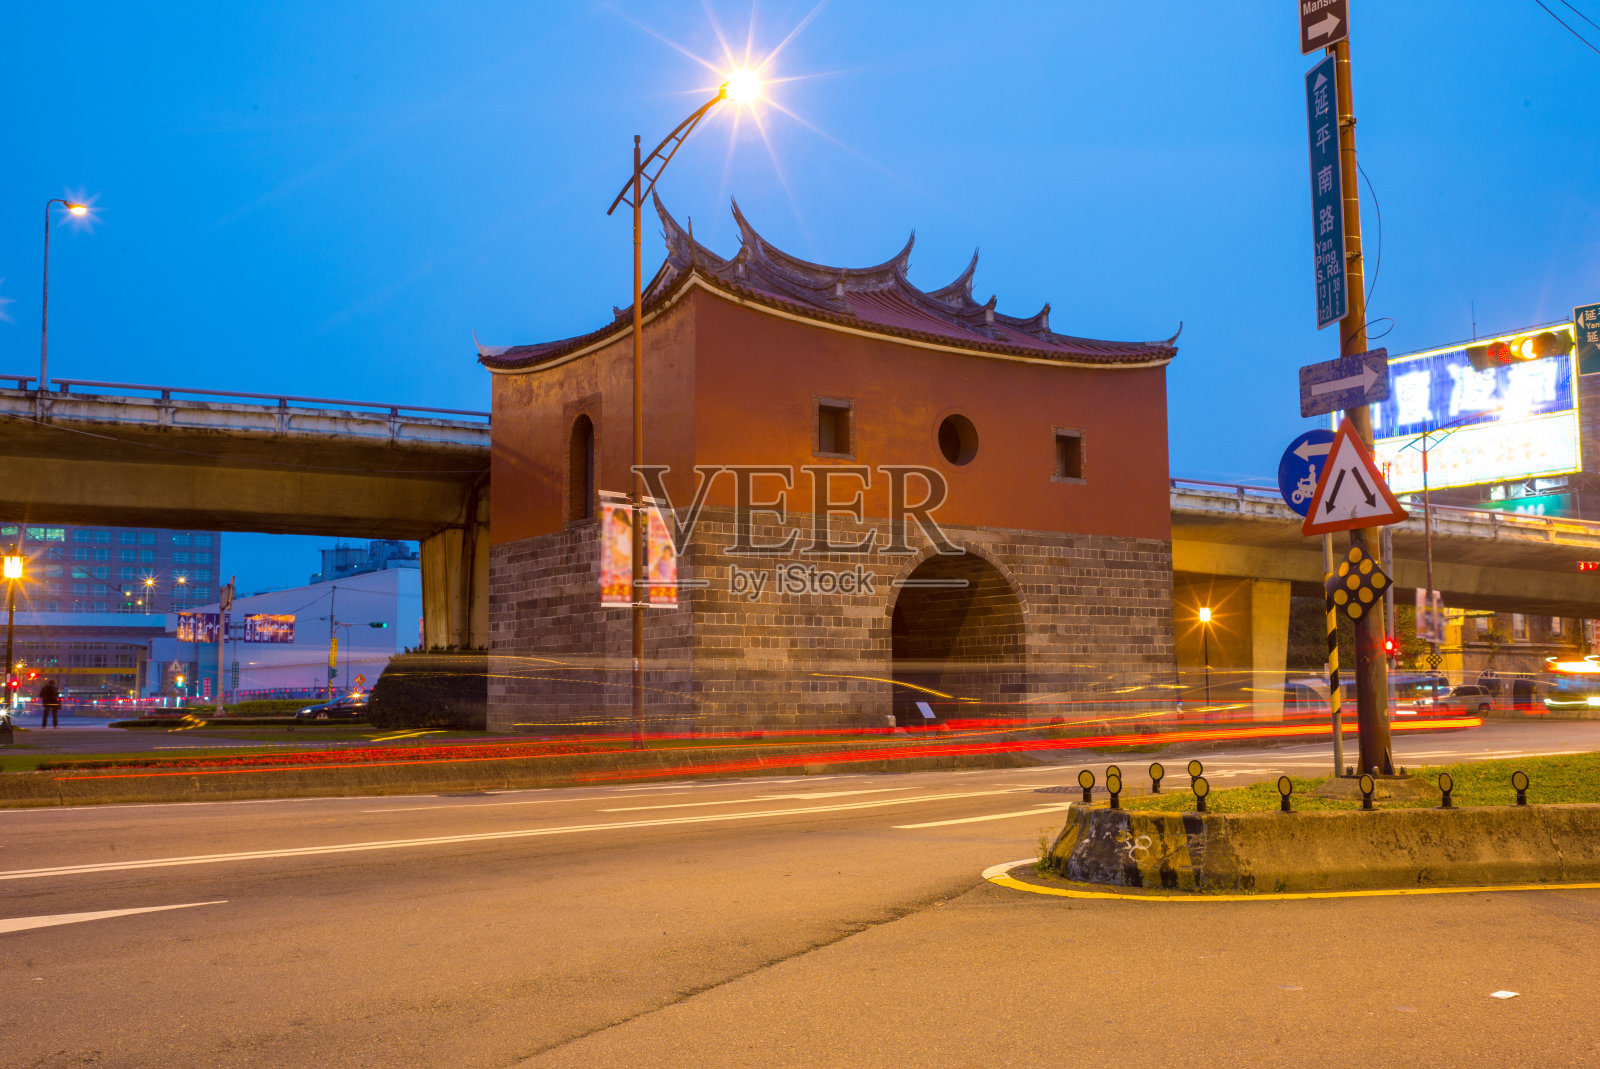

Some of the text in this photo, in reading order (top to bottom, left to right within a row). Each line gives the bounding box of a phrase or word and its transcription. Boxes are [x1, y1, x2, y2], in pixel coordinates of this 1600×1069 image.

[1314, 84, 1335, 237] 延平南路
[1316, 238, 1333, 254] Yan
[1316, 250, 1336, 269] Ping
[1317, 261, 1342, 283] S. Rd.
[1585, 308, 1600, 321] 延
